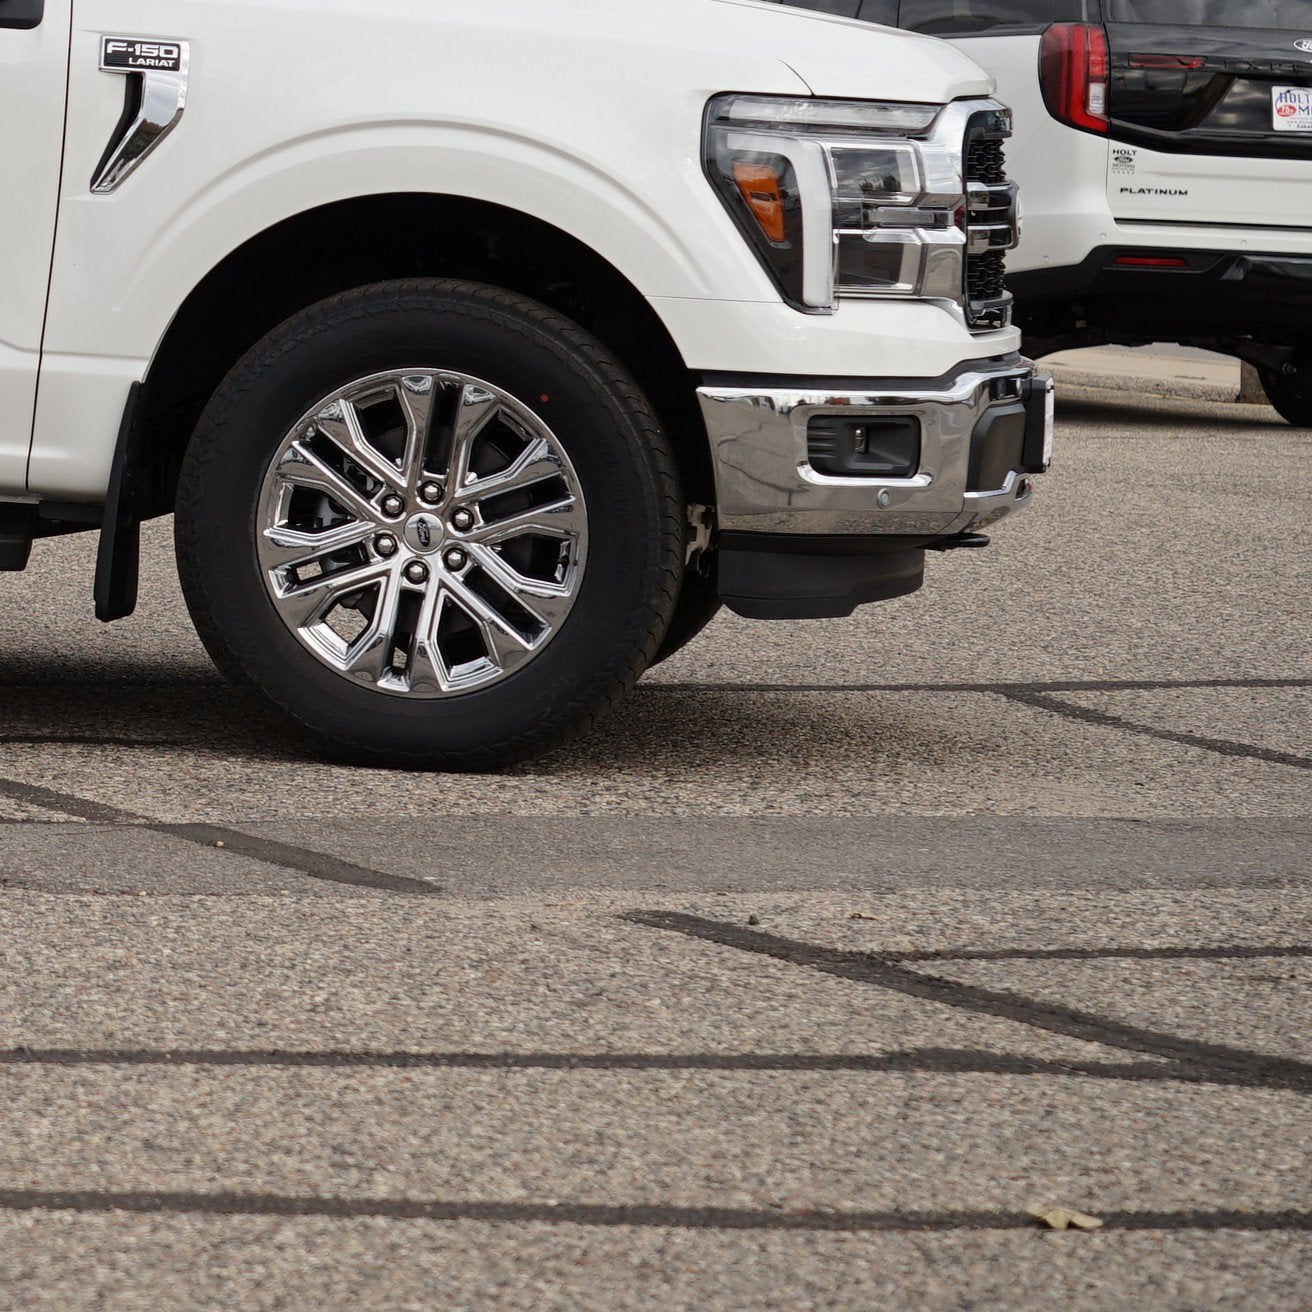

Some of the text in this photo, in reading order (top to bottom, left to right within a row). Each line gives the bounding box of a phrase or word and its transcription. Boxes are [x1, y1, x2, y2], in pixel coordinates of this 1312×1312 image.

[106, 41, 180, 59] F-150
[128, 57, 176, 68] LARIAT
[1279, 91, 1310, 104] HOLT
[1120, 187, 1189, 196] PLATINUM
[417, 522, 430, 544] Ford
